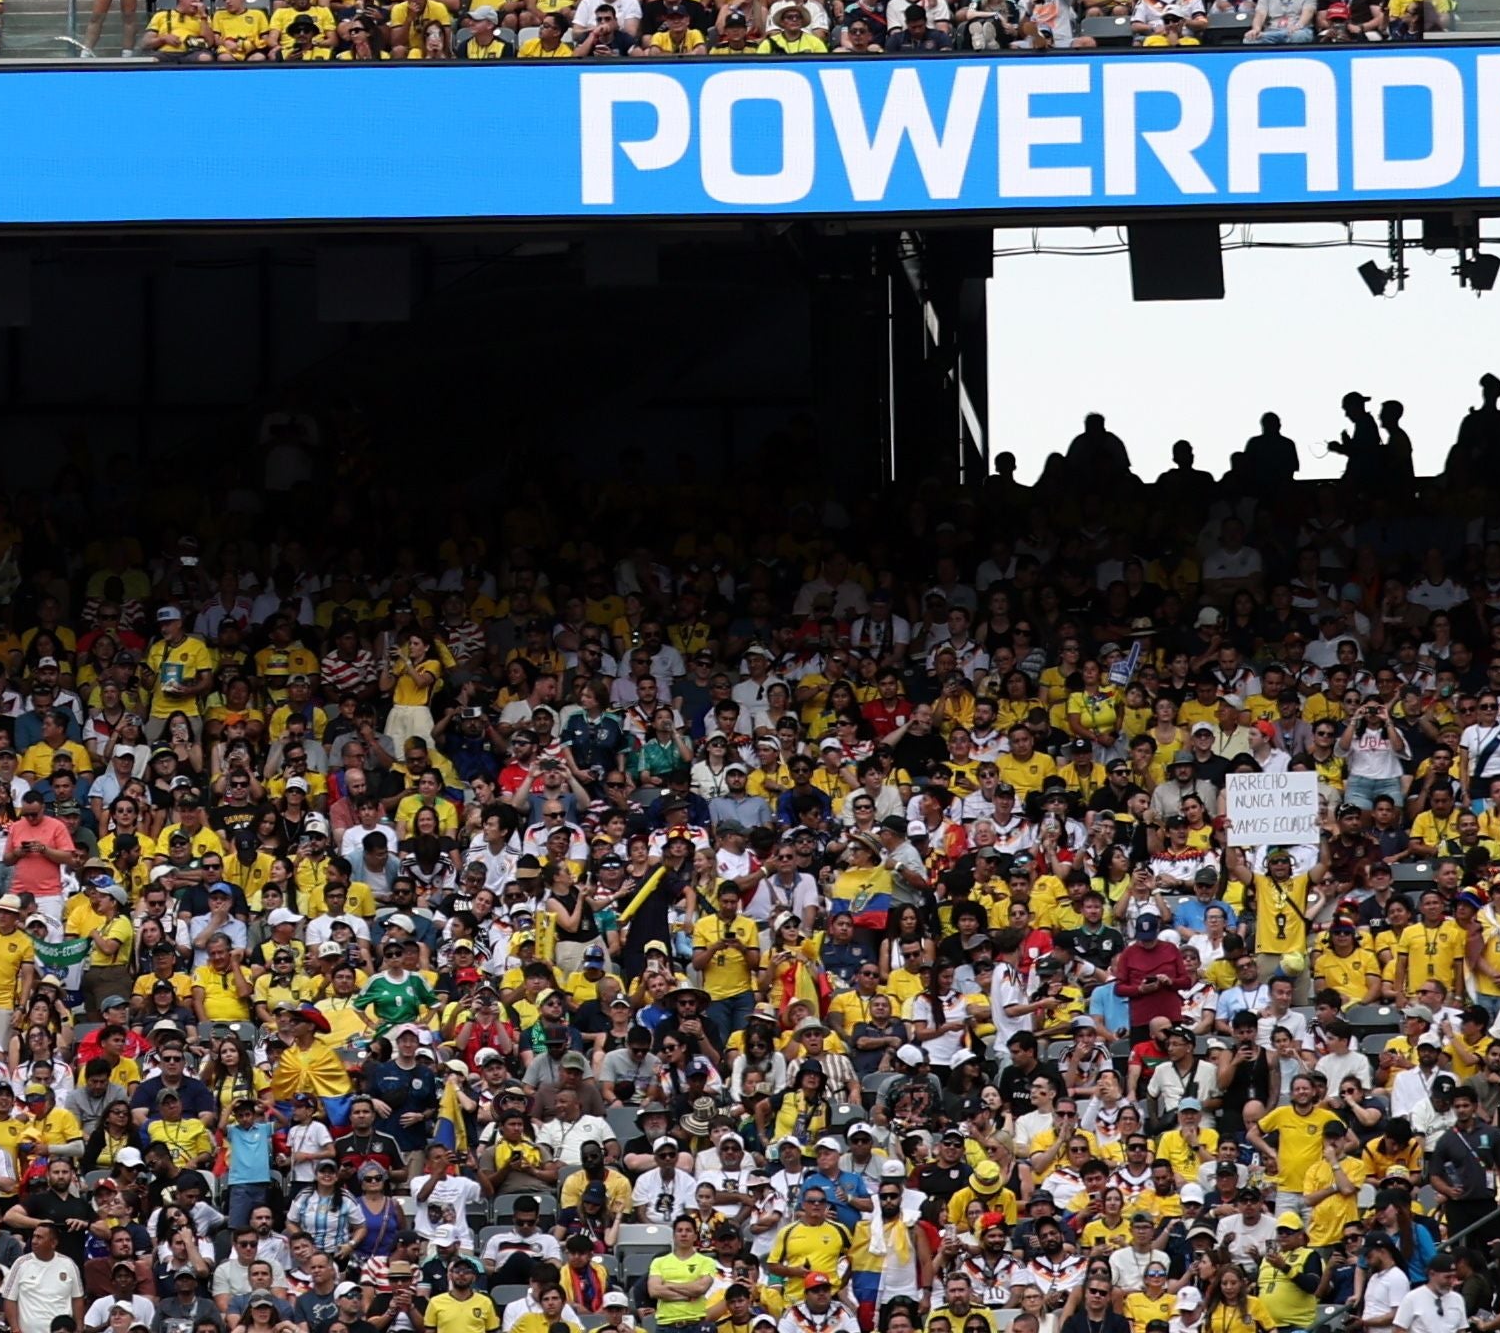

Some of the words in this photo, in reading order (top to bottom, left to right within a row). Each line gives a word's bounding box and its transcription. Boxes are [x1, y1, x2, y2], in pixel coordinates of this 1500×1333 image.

[1228, 773, 1289, 792] ARRECHO
[1235, 792, 1275, 810] NUNCA
[1280, 789, 1313, 808] MUERE
[1230, 816, 1270, 836] VAMOS
[1272, 812, 1318, 835] ECUADOR
